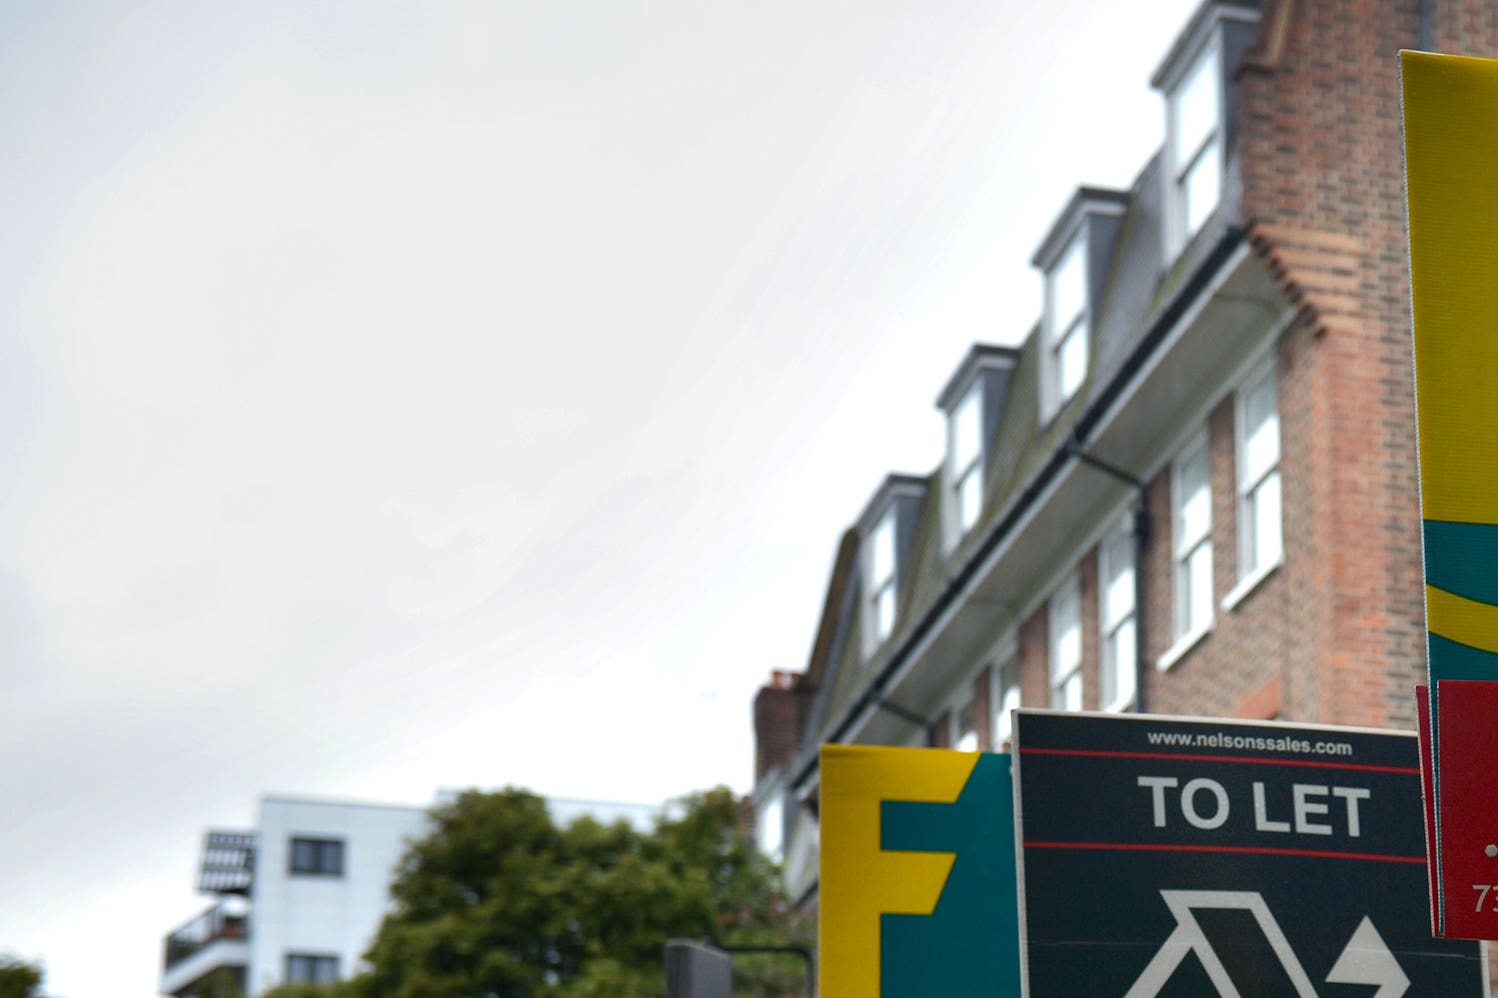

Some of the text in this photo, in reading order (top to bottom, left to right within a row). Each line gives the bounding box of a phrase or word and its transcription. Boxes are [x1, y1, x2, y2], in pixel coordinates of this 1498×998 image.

[1148, 732, 1352, 756] www.nelsonssales.com
[1138, 776, 1371, 837] TO LET
